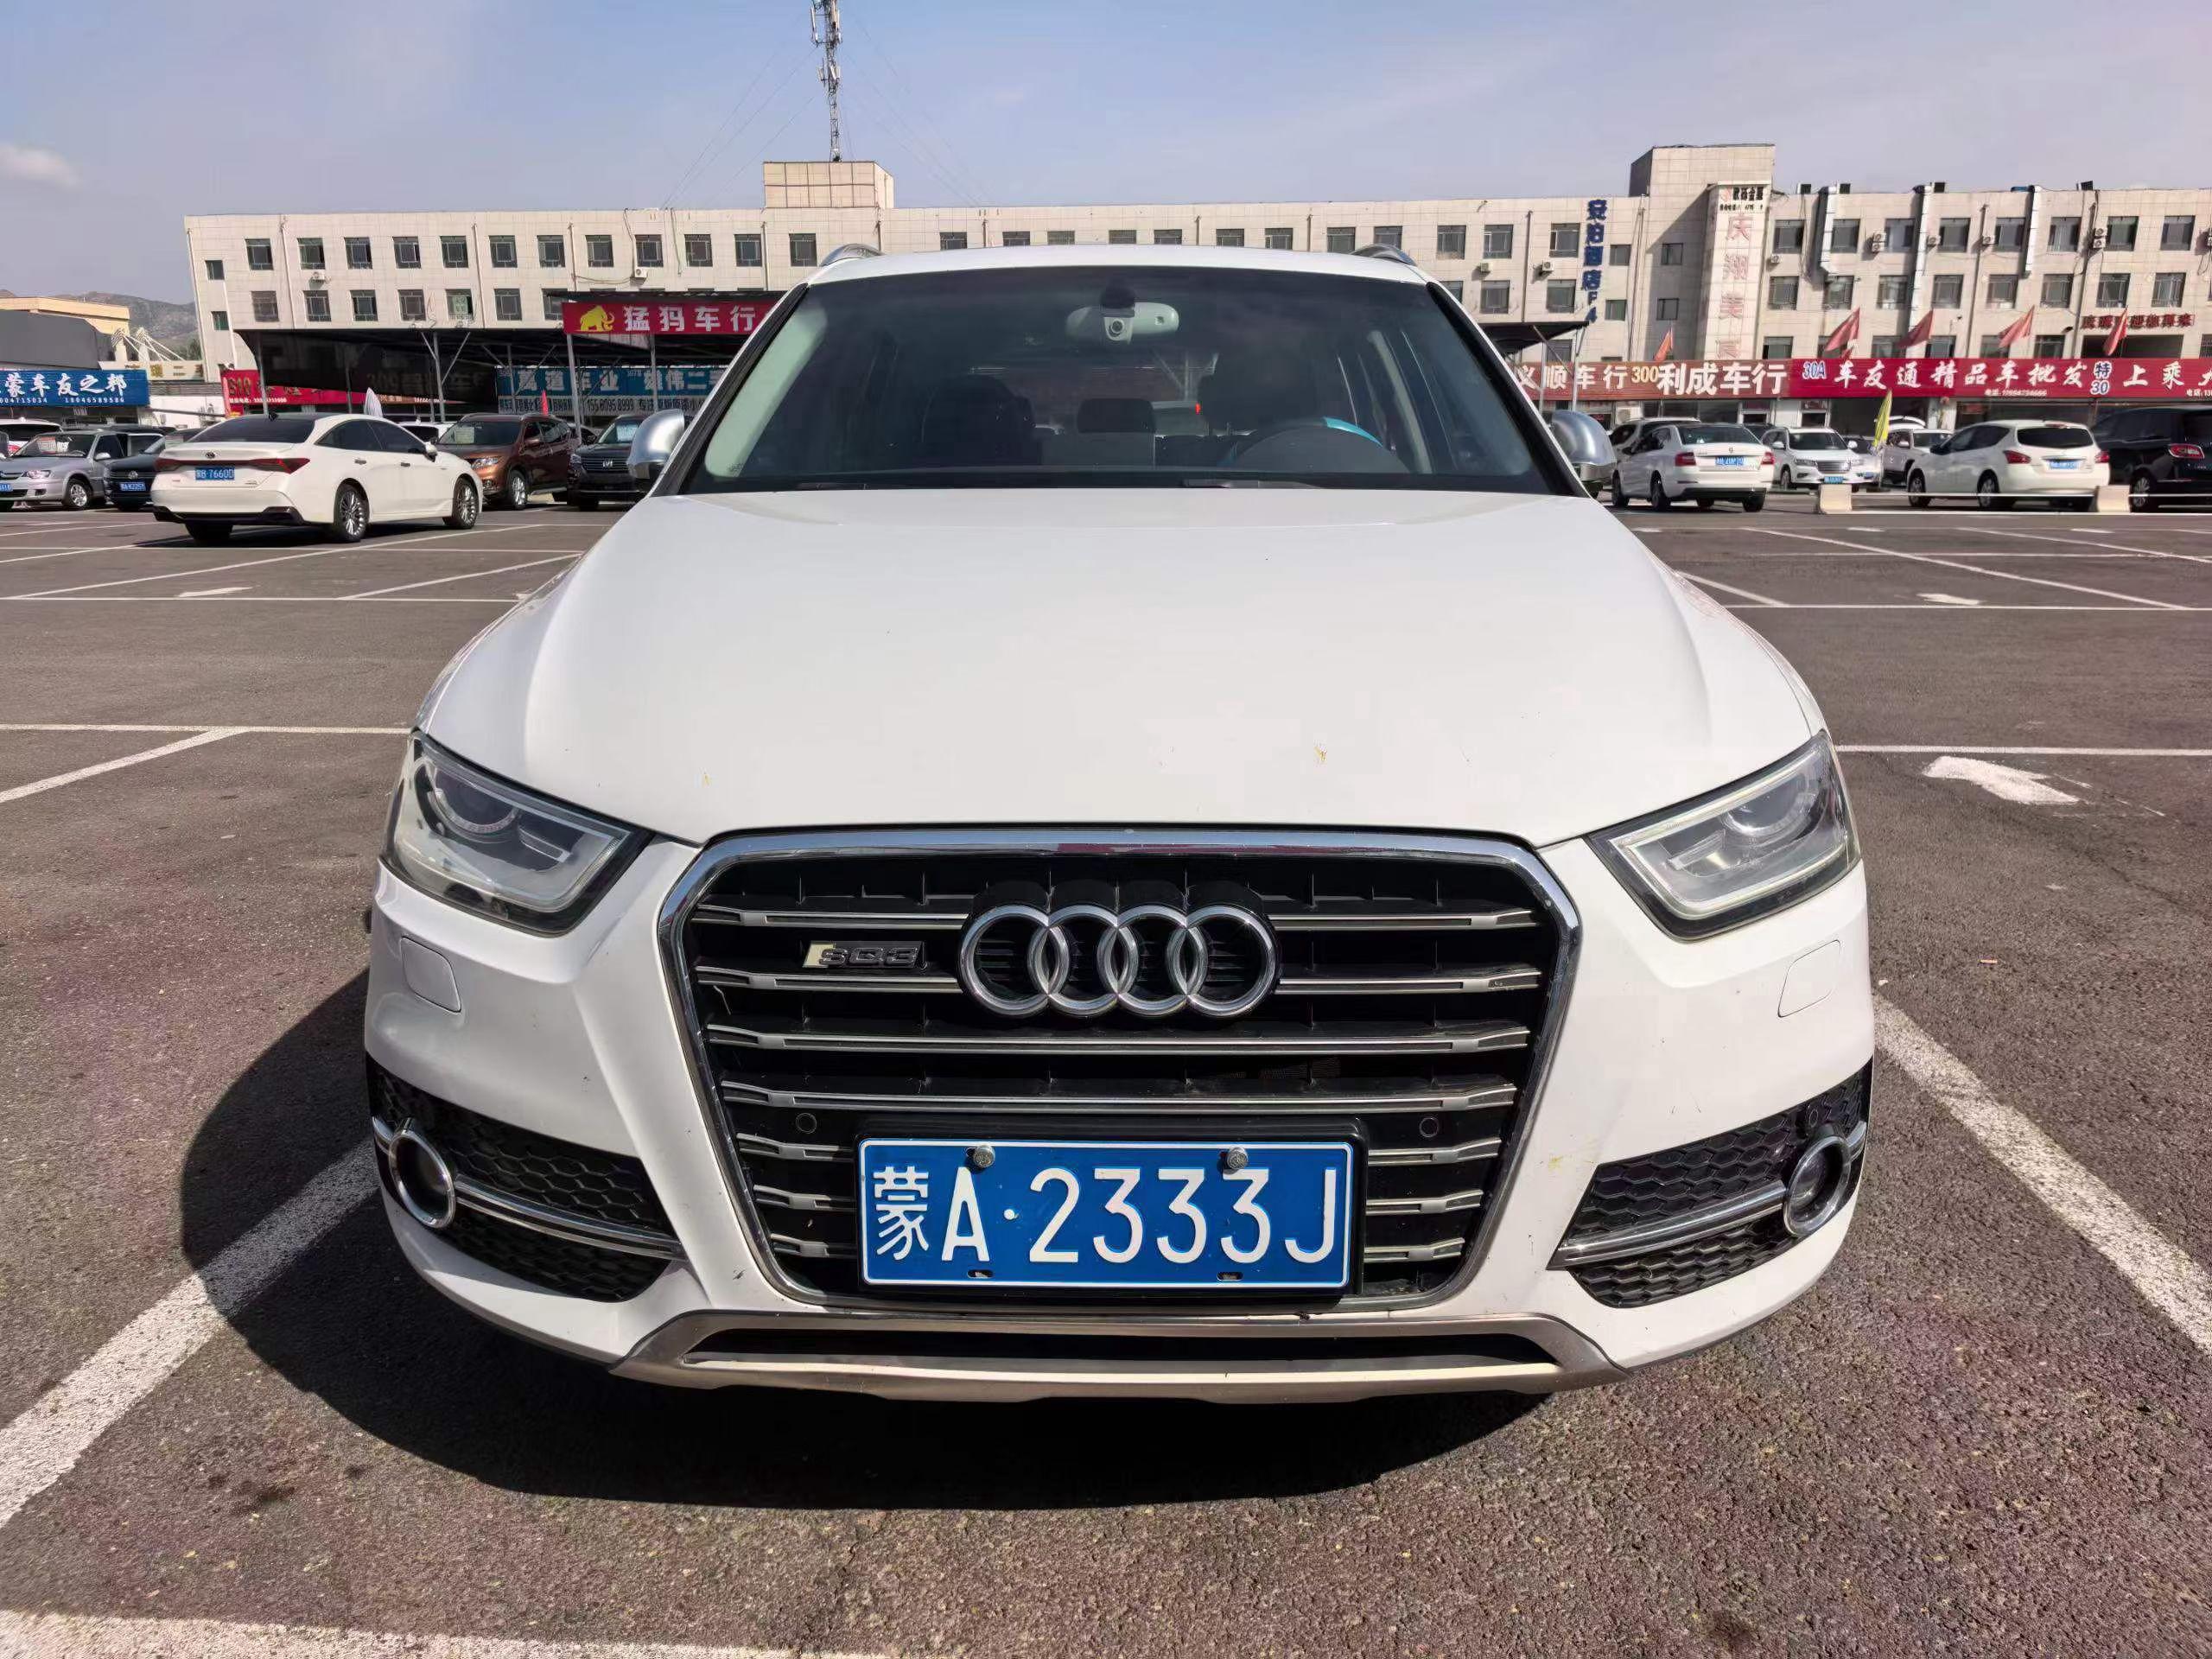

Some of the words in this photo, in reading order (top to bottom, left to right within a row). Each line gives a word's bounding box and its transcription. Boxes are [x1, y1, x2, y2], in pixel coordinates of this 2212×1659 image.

[623, 305, 756, 332] 猛犸车行
[1630, 365, 1660, 384] 300
[1656, 361, 1788, 396] 利成车行
[1834, 359, 2088, 389] 车友通精品车批发
[2094, 361, 2112, 378] 特
[0, 372, 127, 397] 蒙车友之邦
[2090, 381, 2110, 395] 30
[873, 1166, 1336, 1264] 蒙A·2333J
